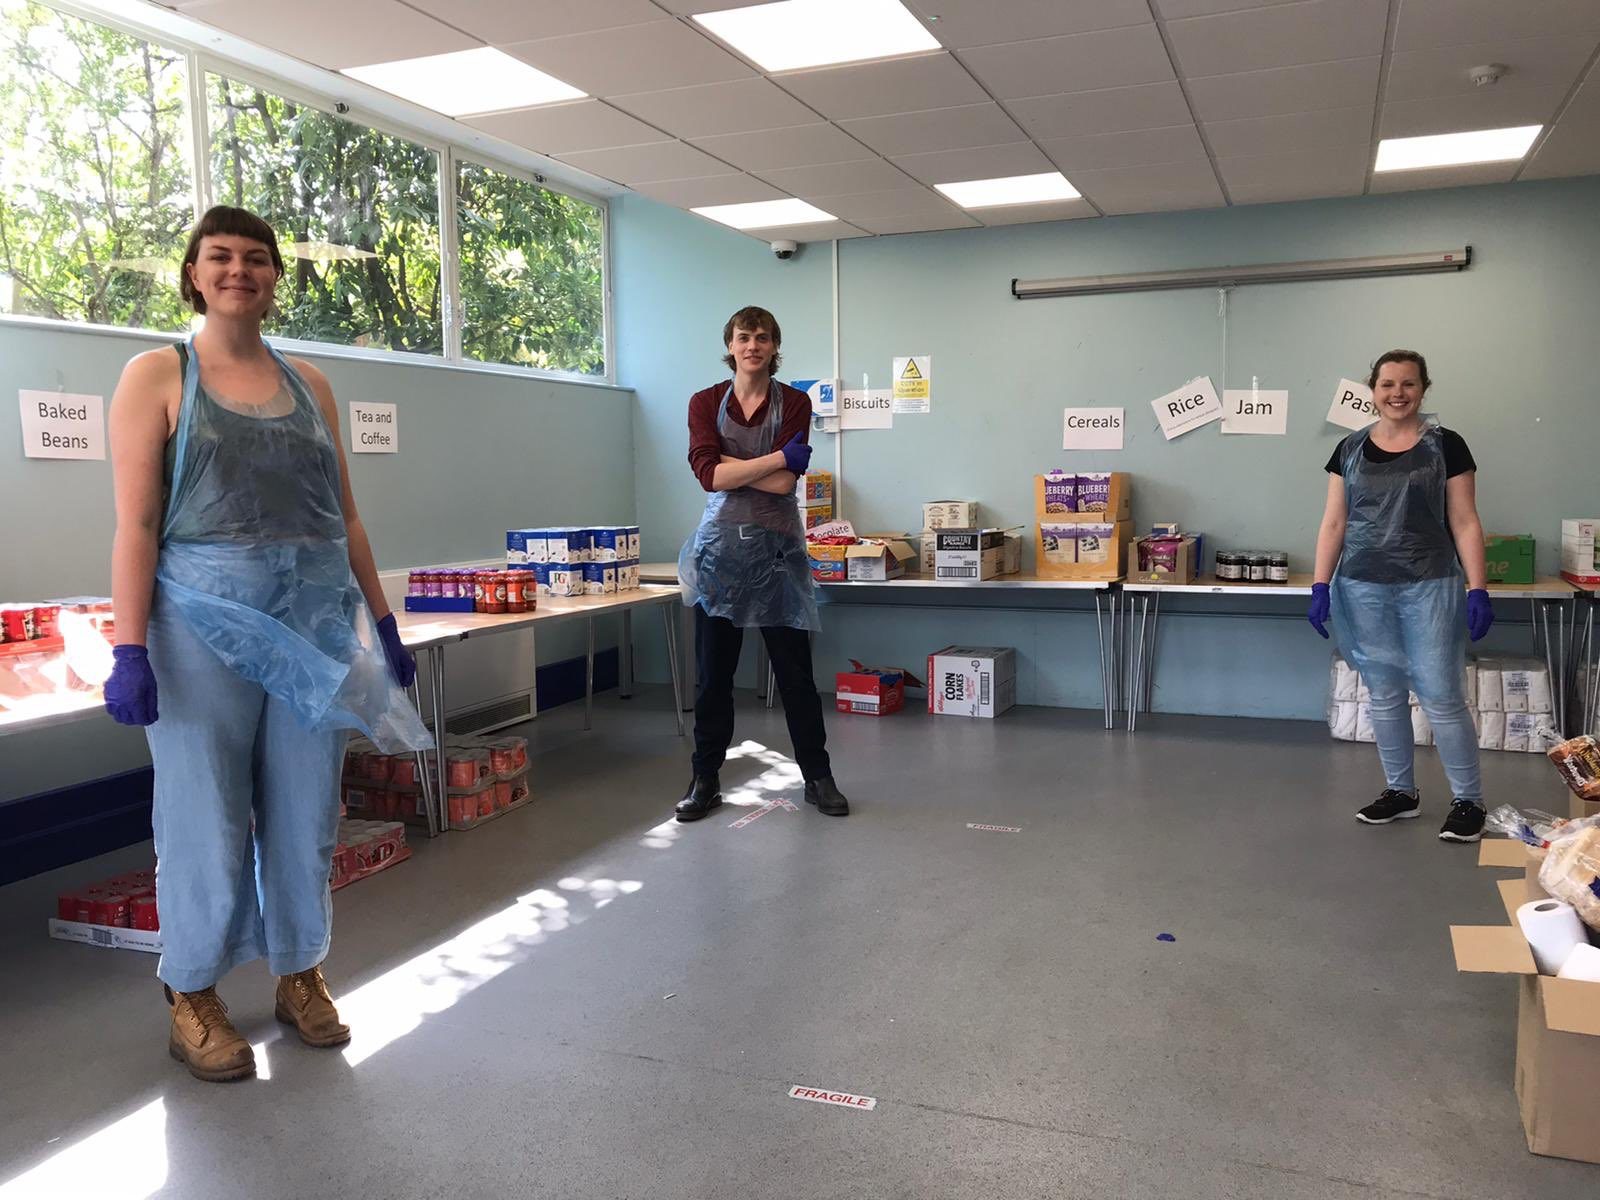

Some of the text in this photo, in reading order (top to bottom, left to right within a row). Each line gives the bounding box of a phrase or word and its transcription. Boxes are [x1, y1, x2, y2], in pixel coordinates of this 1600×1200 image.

[38, 401, 87, 421] Baked
[843, 397, 890, 410] Biscuits
[1167, 393, 1205, 418] Rice
[1235, 399, 1273, 415] Jam
[355, 409, 392, 424] Tea and
[1067, 414, 1120, 429] Cereals
[41, 431, 89, 449] Beans
[361, 431, 391, 445] Coffee
[1045, 485, 1075, 496] UEBERRY
[1077, 484, 1110, 496] BLUEBER
[813, 525, 849, 538] ocolate
[553, 572, 567, 584] PG
[945, 672, 956, 701] CORN
[956, 673, 964, 701] FLAKES
[793, 1088, 871, 1107] FRAGILE
